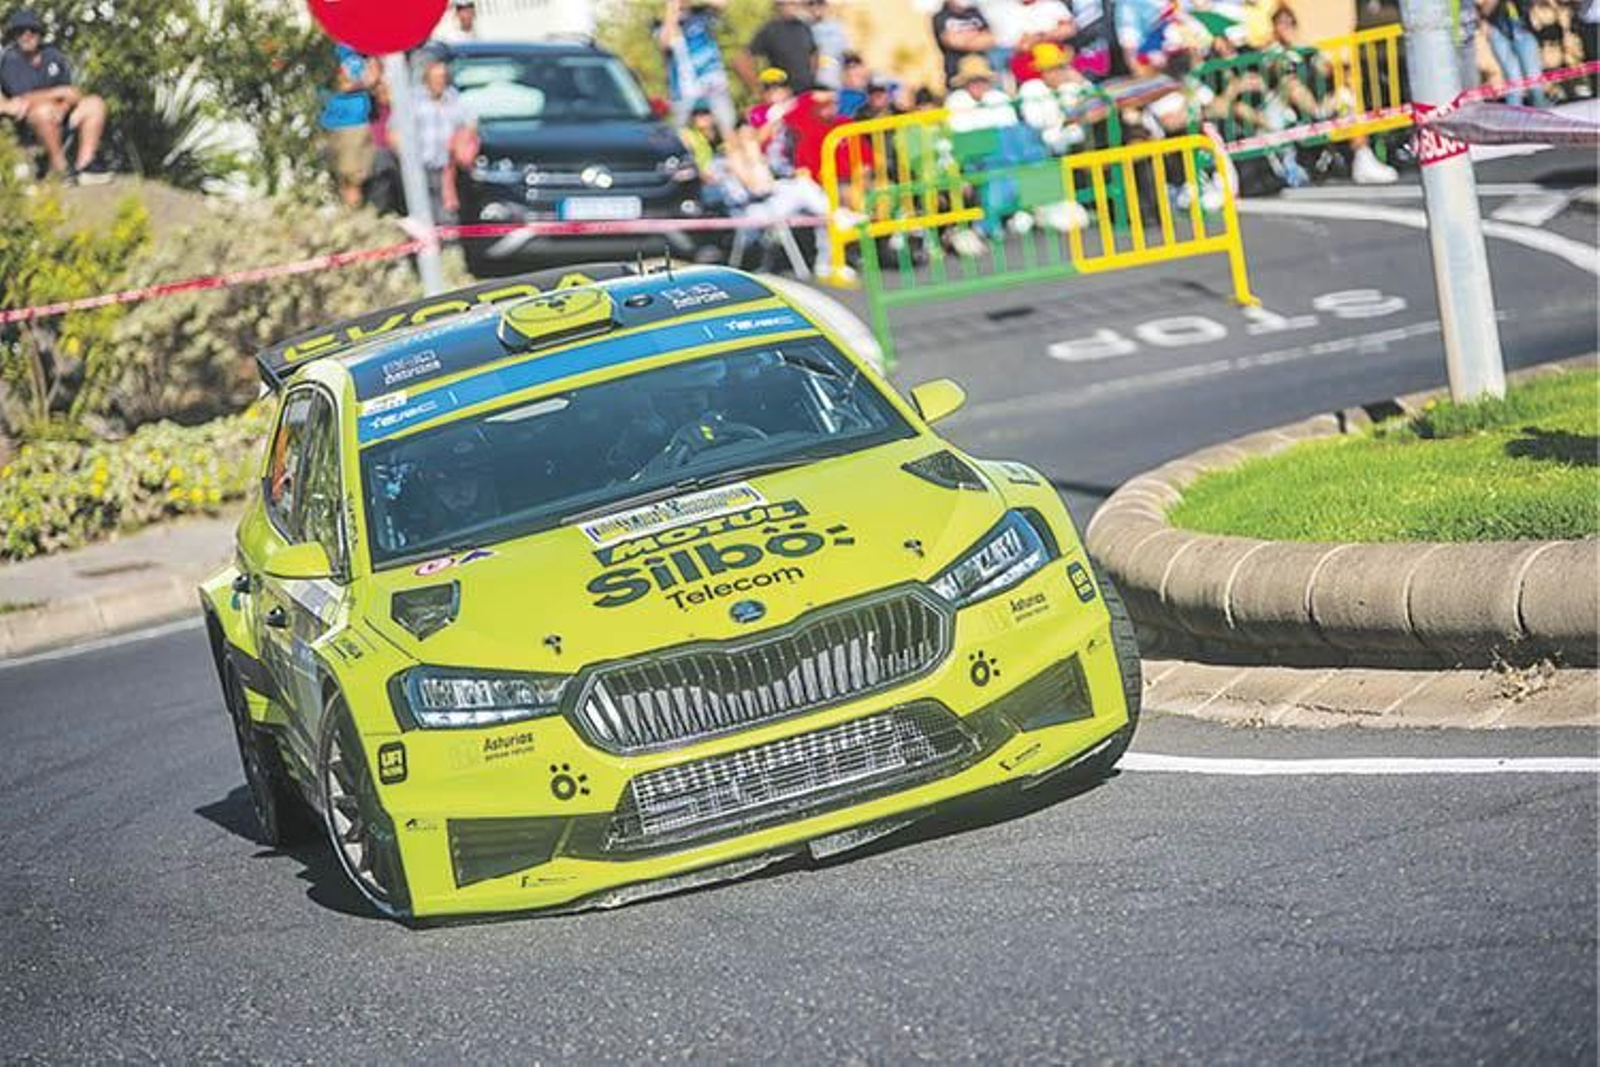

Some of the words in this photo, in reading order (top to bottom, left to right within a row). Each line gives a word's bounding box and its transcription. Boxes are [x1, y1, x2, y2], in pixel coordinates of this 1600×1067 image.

[1048, 288, 1408, 363] STOP
[592, 499, 809, 567] MOTUL
[665, 566, 806, 611] Telecom
[483, 733, 533, 752] Asturias
